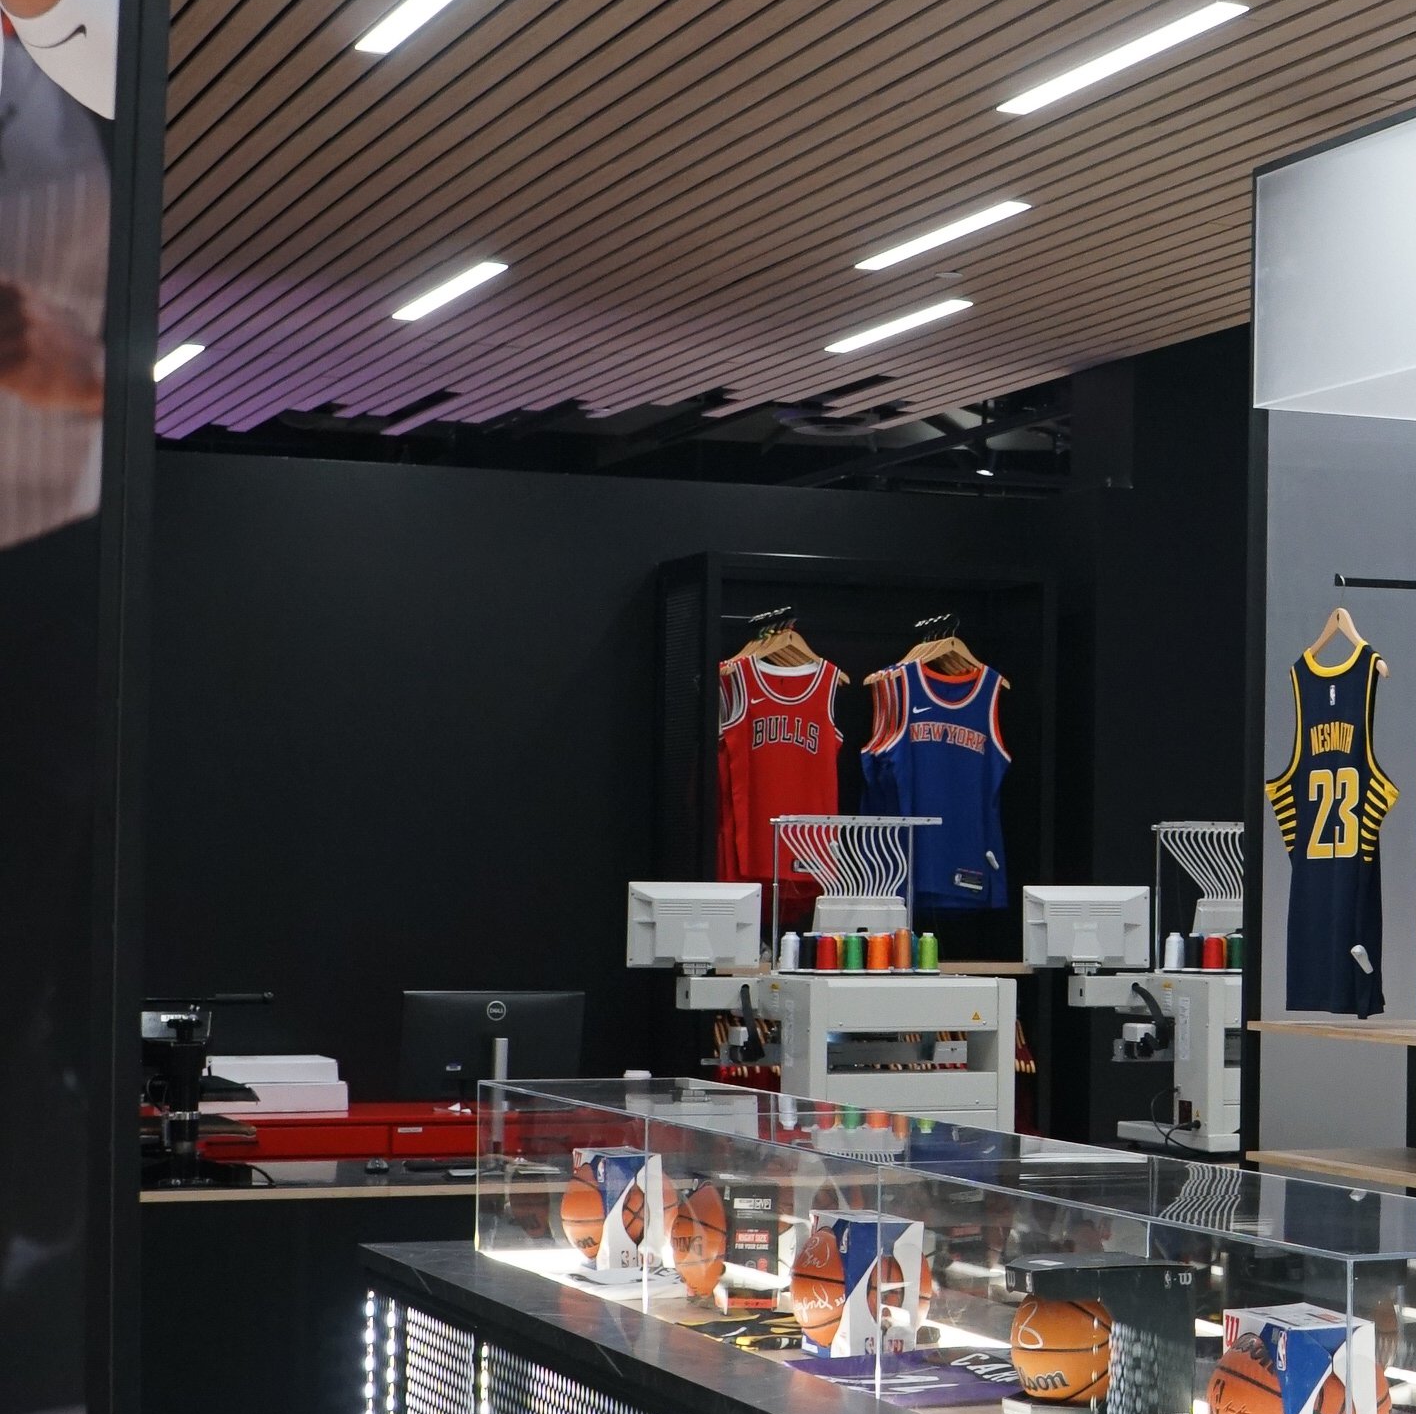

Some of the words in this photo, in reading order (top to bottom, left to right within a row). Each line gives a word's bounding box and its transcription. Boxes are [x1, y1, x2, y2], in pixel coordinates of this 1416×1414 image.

[752, 715, 820, 755] BULLS
[909, 721, 949, 742] NEW
[947, 723, 987, 755] YORK
[1309, 721, 1354, 756] NESMITH
[1307, 767, 1359, 859] 23
